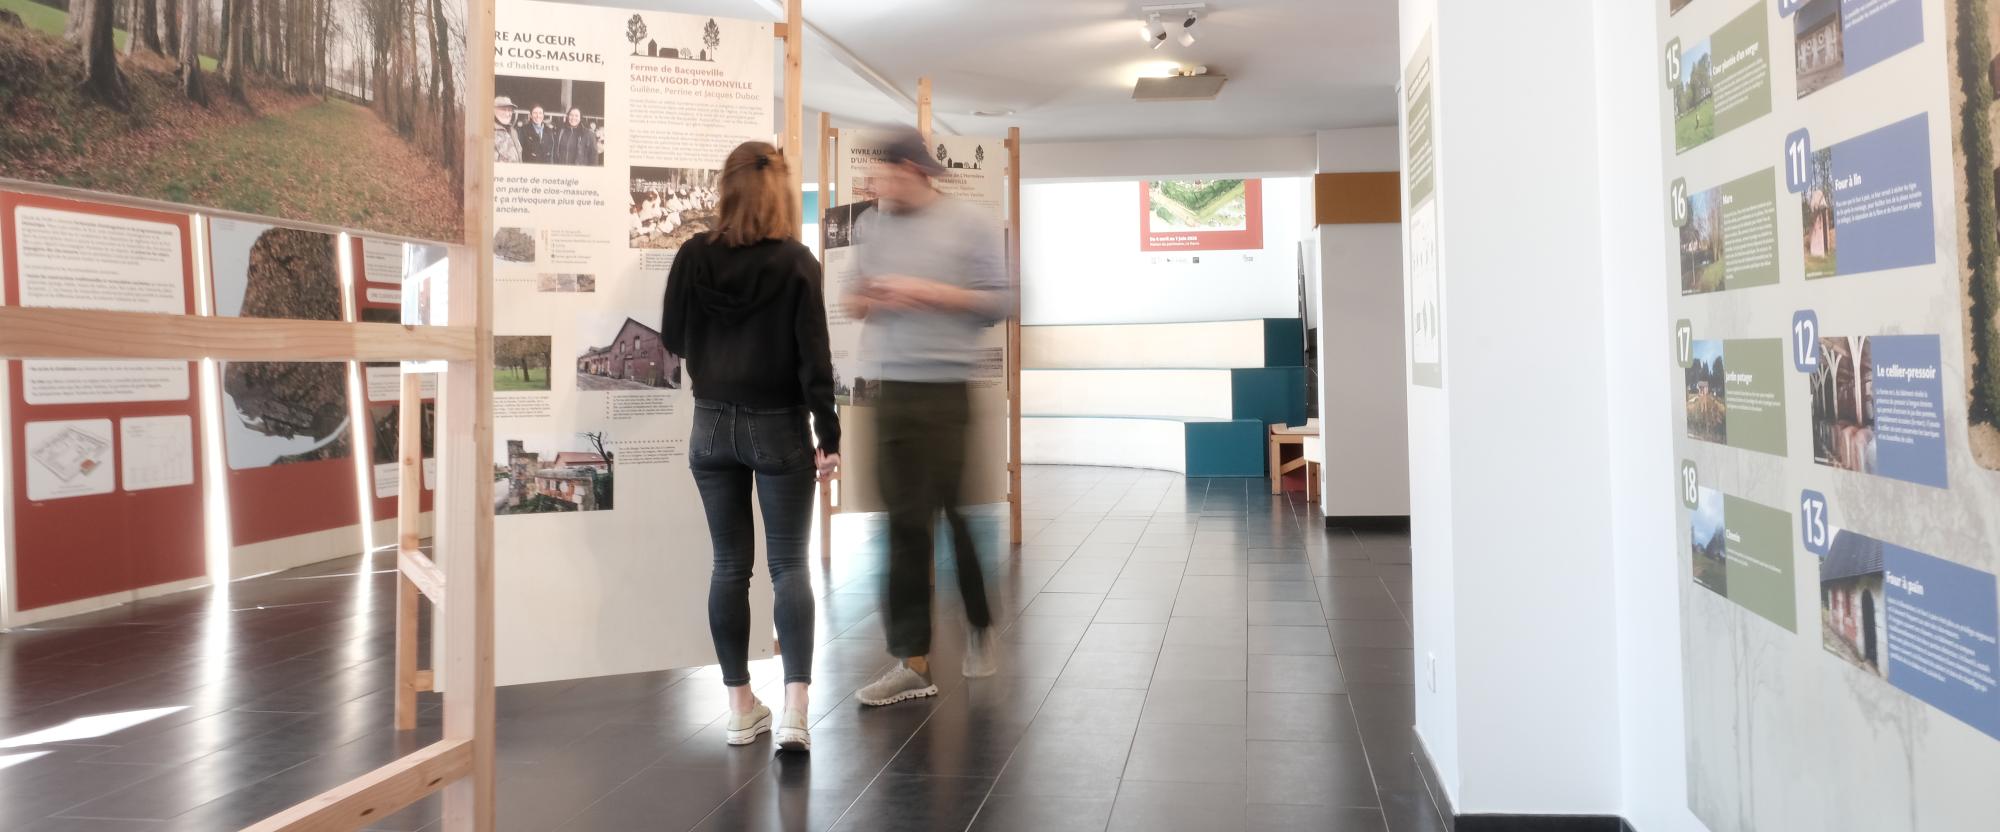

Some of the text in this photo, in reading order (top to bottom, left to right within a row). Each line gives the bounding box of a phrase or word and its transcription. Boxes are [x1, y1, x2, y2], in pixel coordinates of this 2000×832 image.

[513, 33, 532, 43] AU
[536, 34, 576, 47] CŒUR
[508, 48, 605, 65] CLOS-MASURE,
[1667, 44, 1680, 82] 15
[507, 61, 559, 71] d'habitants
[631, 63, 723, 77] Ferme de Bacqueville
[630, 74, 752, 89] SAINT-VIGOR-D'YMONVILLE
[665, 87, 692, 97] Perrine
[695, 89, 702, 97] et
[705, 88, 733, 101] Jacques
[1790, 138, 1807, 185] 11
[530, 177, 541, 185] de
[543, 178, 579, 188] nostalgie
[1835, 173, 1862, 191] Four à lin
[509, 187, 529, 195] parle
[532, 187, 542, 195] de
[544, 187, 600, 198] clos-masures,
[1723, 194, 1733, 205] Mare
[512, 196, 556, 206] n'évoquera
[558, 197, 575, 207] plus
[594, 199, 605, 207] les
[1672, 184, 1686, 221] 16
[496, 206, 530, 214] anciens.
[1677, 327, 1690, 362] 17
[1795, 320, 1816, 365] 12
[1736, 374, 1752, 385] potager
[1876, 364, 1937, 382] Le cellier-pressoir
[1683, 465, 1697, 503] 18
[1802, 498, 1826, 547] 13
[1886, 571, 1902, 587] Four
[1908, 581, 1924, 595] pain
